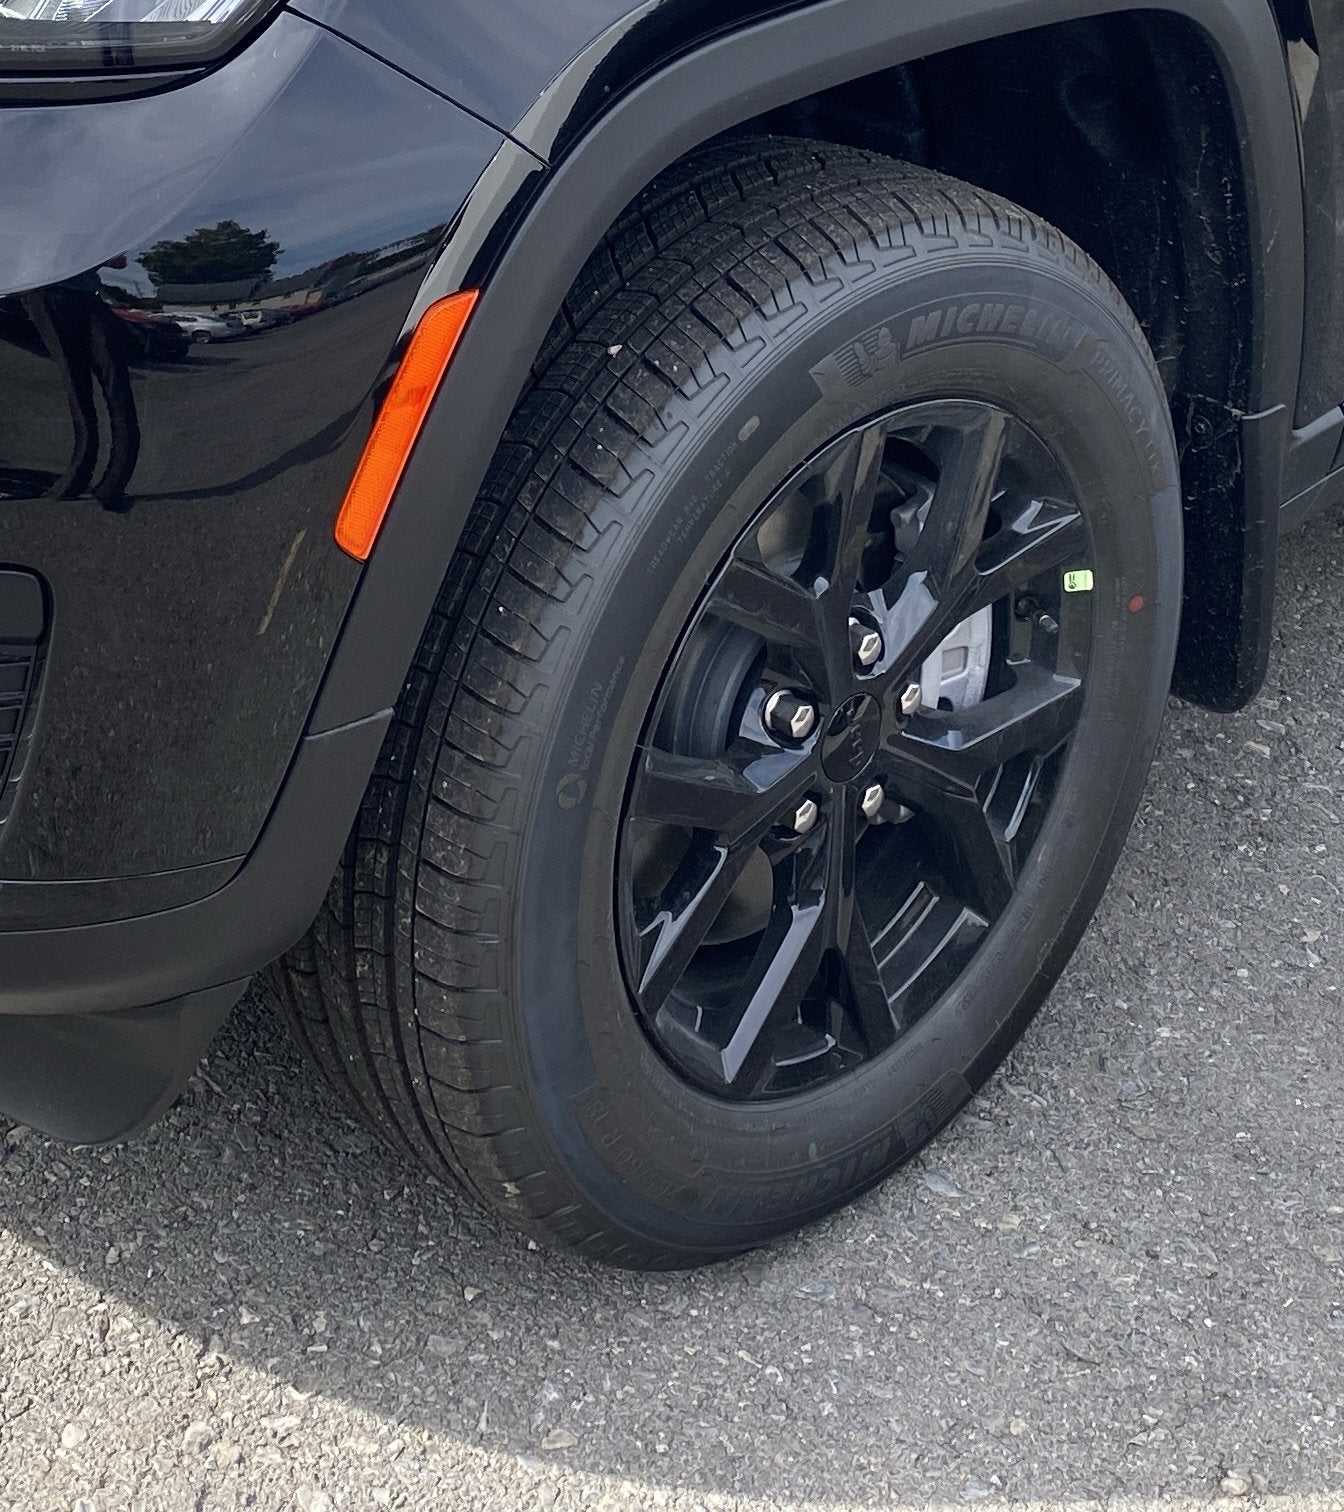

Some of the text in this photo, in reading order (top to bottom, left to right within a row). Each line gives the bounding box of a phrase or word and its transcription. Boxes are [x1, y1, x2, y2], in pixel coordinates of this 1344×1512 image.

[906, 302, 1078, 351] MICHELIN
[1090, 350, 1150, 435] PRIMACY
[568, 681, 605, 768] MICHELIN
